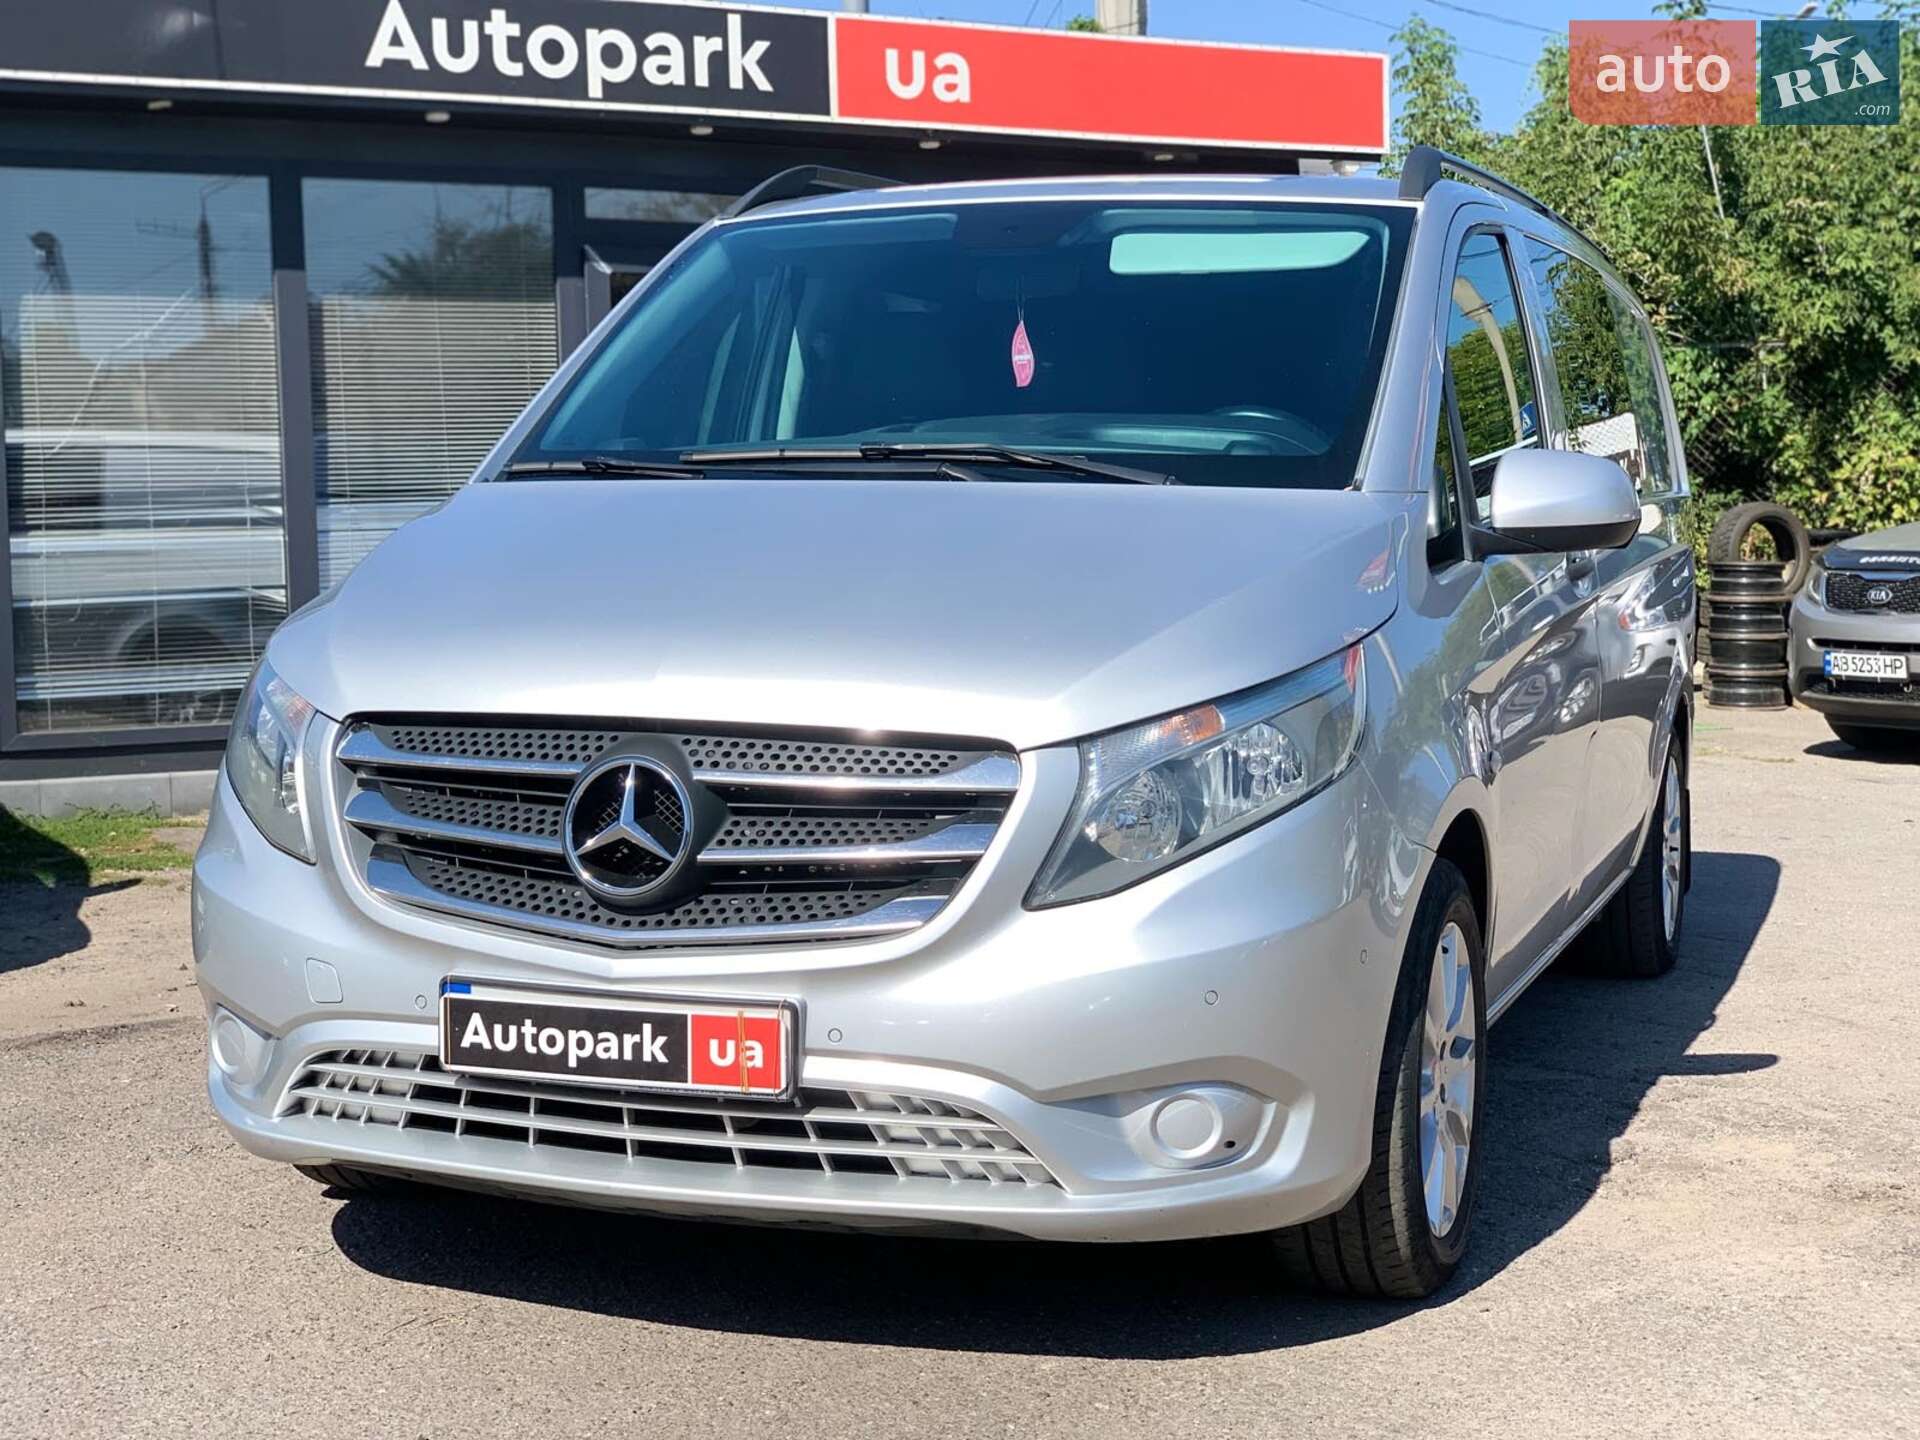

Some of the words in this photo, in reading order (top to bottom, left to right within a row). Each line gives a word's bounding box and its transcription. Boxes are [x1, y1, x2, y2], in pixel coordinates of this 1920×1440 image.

[365, 0, 774, 98] Autopark
[884, 48, 972, 104] ua
[1870, 590, 1887, 600] KIA
[460, 1012, 669, 1068] Autopark
[709, 1037, 764, 1069] ua
